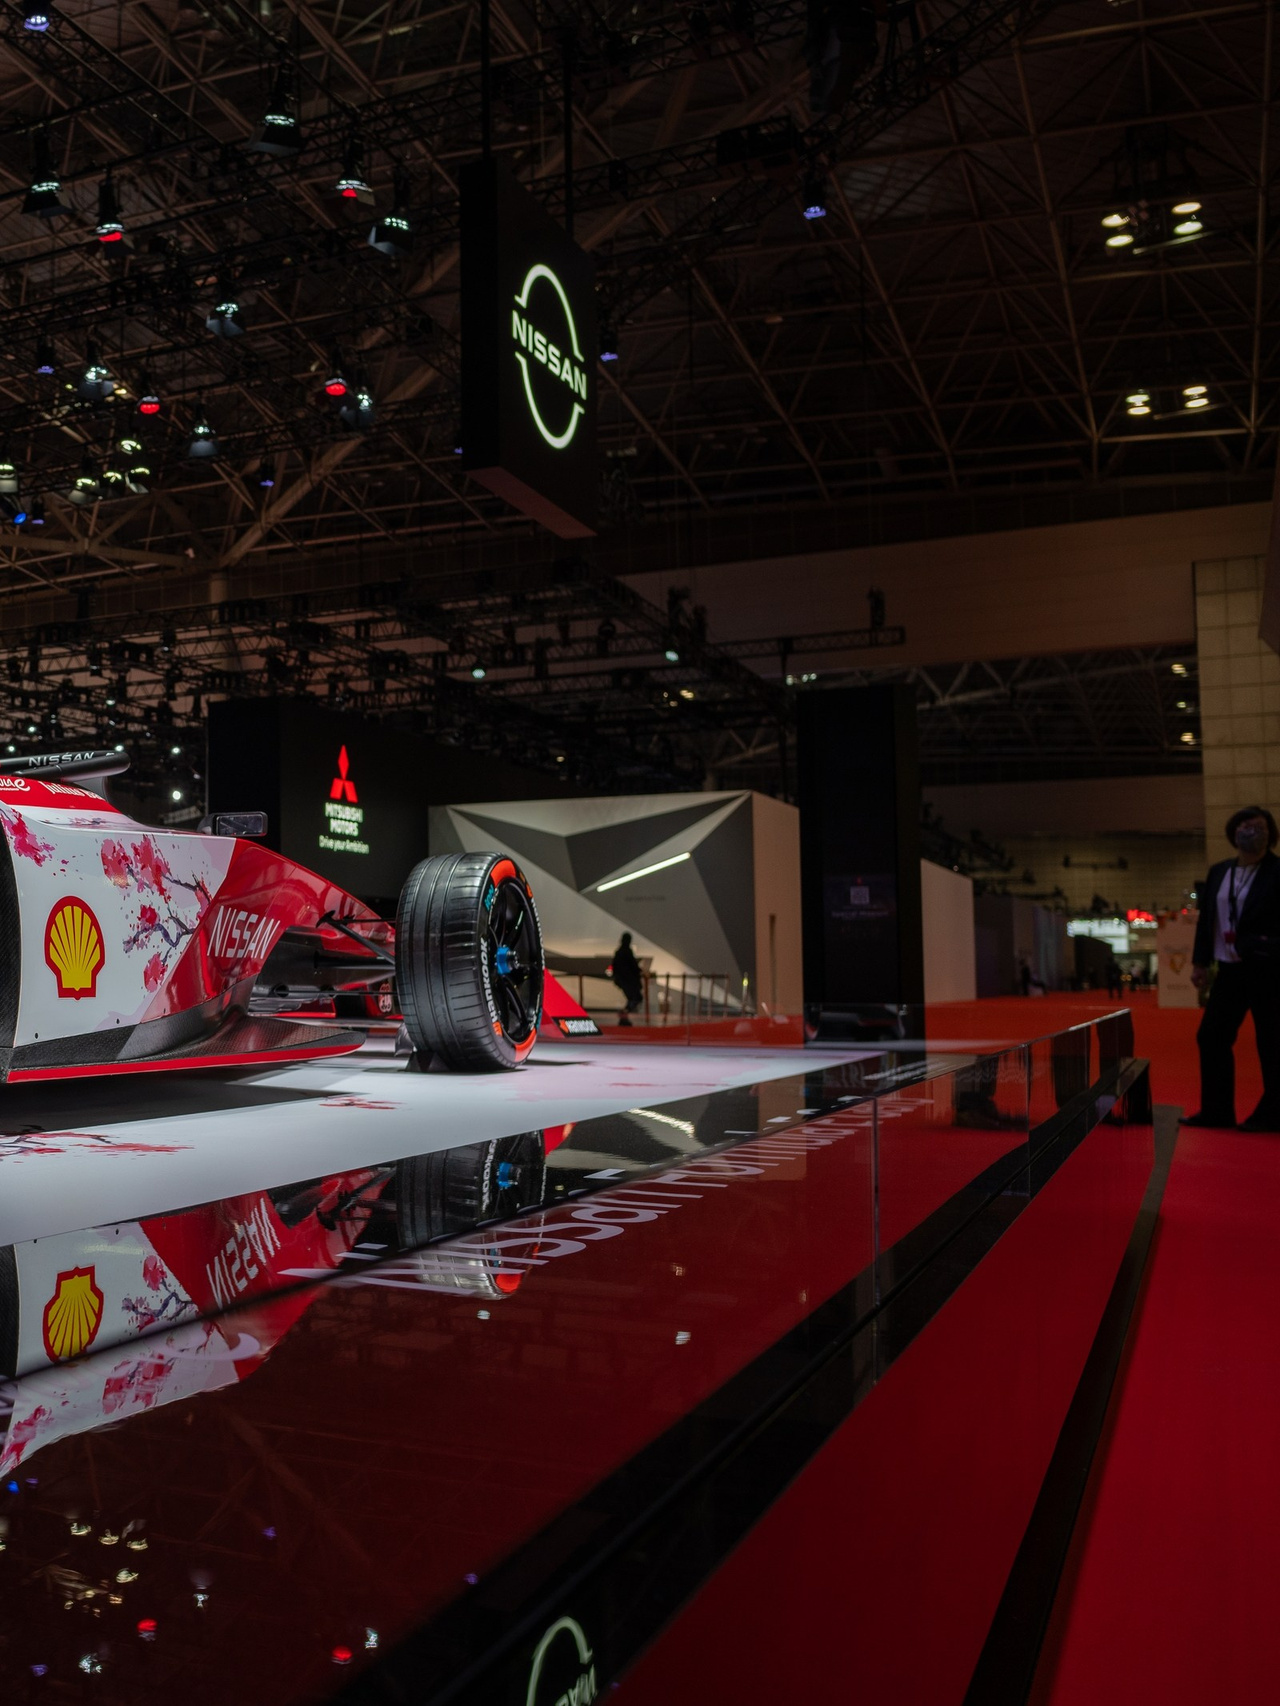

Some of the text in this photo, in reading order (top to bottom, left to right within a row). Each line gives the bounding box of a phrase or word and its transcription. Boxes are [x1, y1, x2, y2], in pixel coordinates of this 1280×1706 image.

[512, 309, 587, 401] NISSAN
[28, 751, 95, 767] NISSAN
[206, 905, 281, 960] NISSAN
